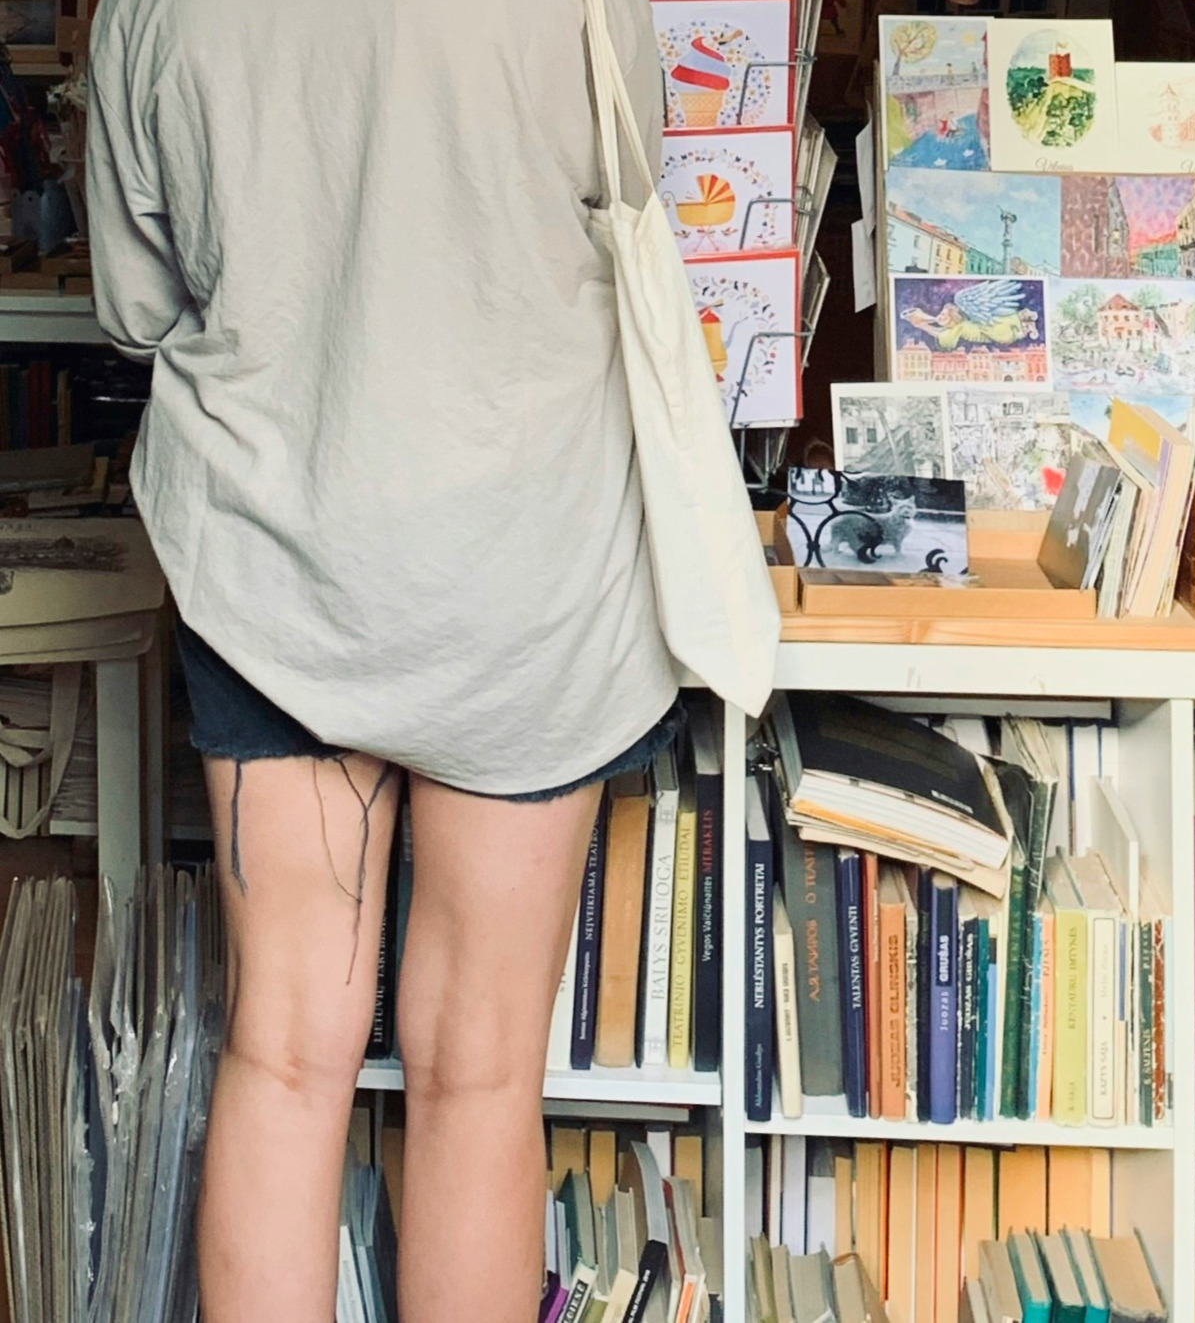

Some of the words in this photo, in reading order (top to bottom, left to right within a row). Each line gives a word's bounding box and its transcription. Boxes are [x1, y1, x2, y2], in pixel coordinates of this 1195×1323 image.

[654, 854, 672, 936] SRUOGA
[753, 863, 765, 924] PORTRETAI
[675, 889, 688, 965] GYVENIMO
[702, 933, 714, 962] Vegos
[806, 920, 819, 972] ТАИРОВ
[848, 906, 860, 953] GYVENTI
[650, 943, 667, 1000] BALYS
[850, 955, 862, 1009] TALENTAS
[936, 936, 949, 983] GRUŠAS
[673, 975, 686, 1047] TEATRINIO
[939, 992, 949, 1031] Juozas
[888, 1019, 902, 1088] JUOZAS
